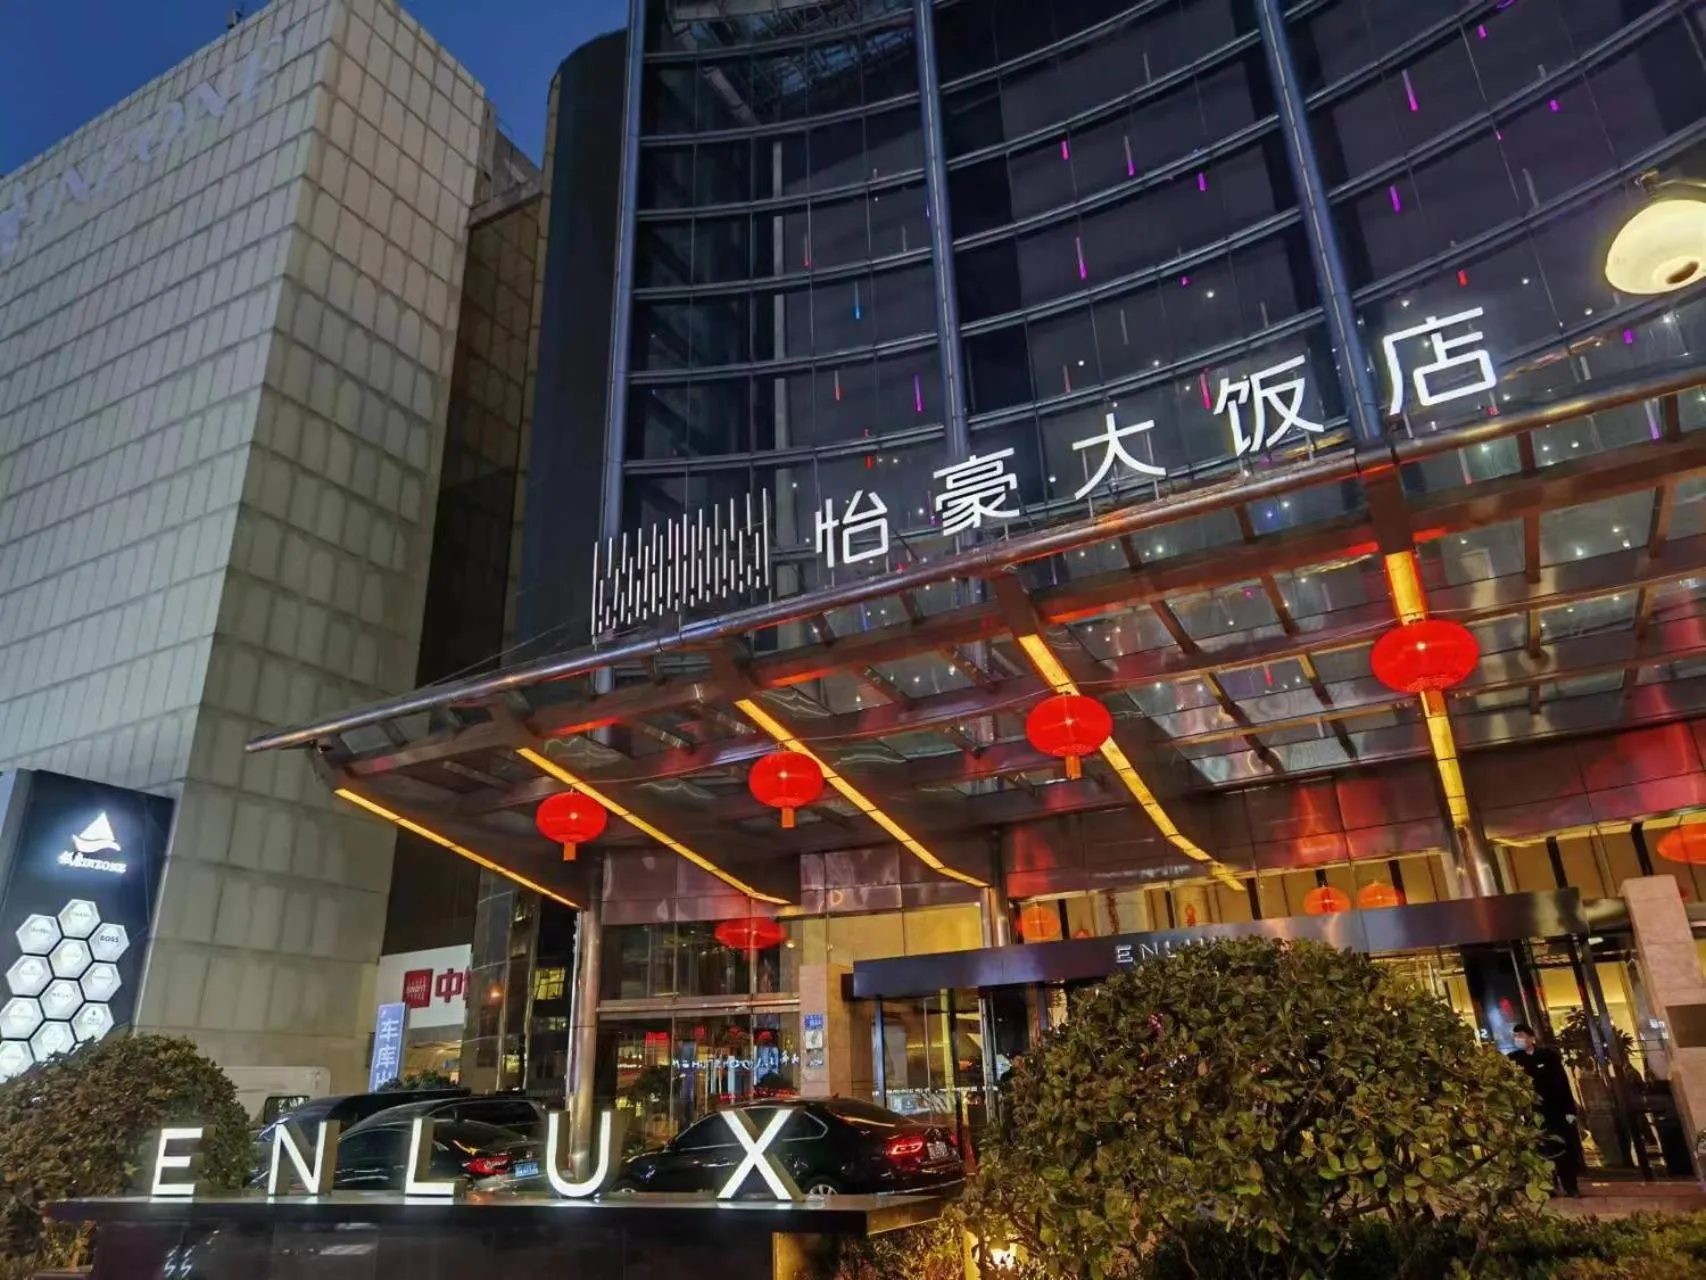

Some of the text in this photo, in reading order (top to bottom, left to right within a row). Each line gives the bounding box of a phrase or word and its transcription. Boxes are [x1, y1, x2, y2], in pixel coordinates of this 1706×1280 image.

[815, 306, 1498, 569] 怡豪大饭店
[100, 935, 119, 943] BOSS
[151, 1109, 793, 1200] ENLUX
